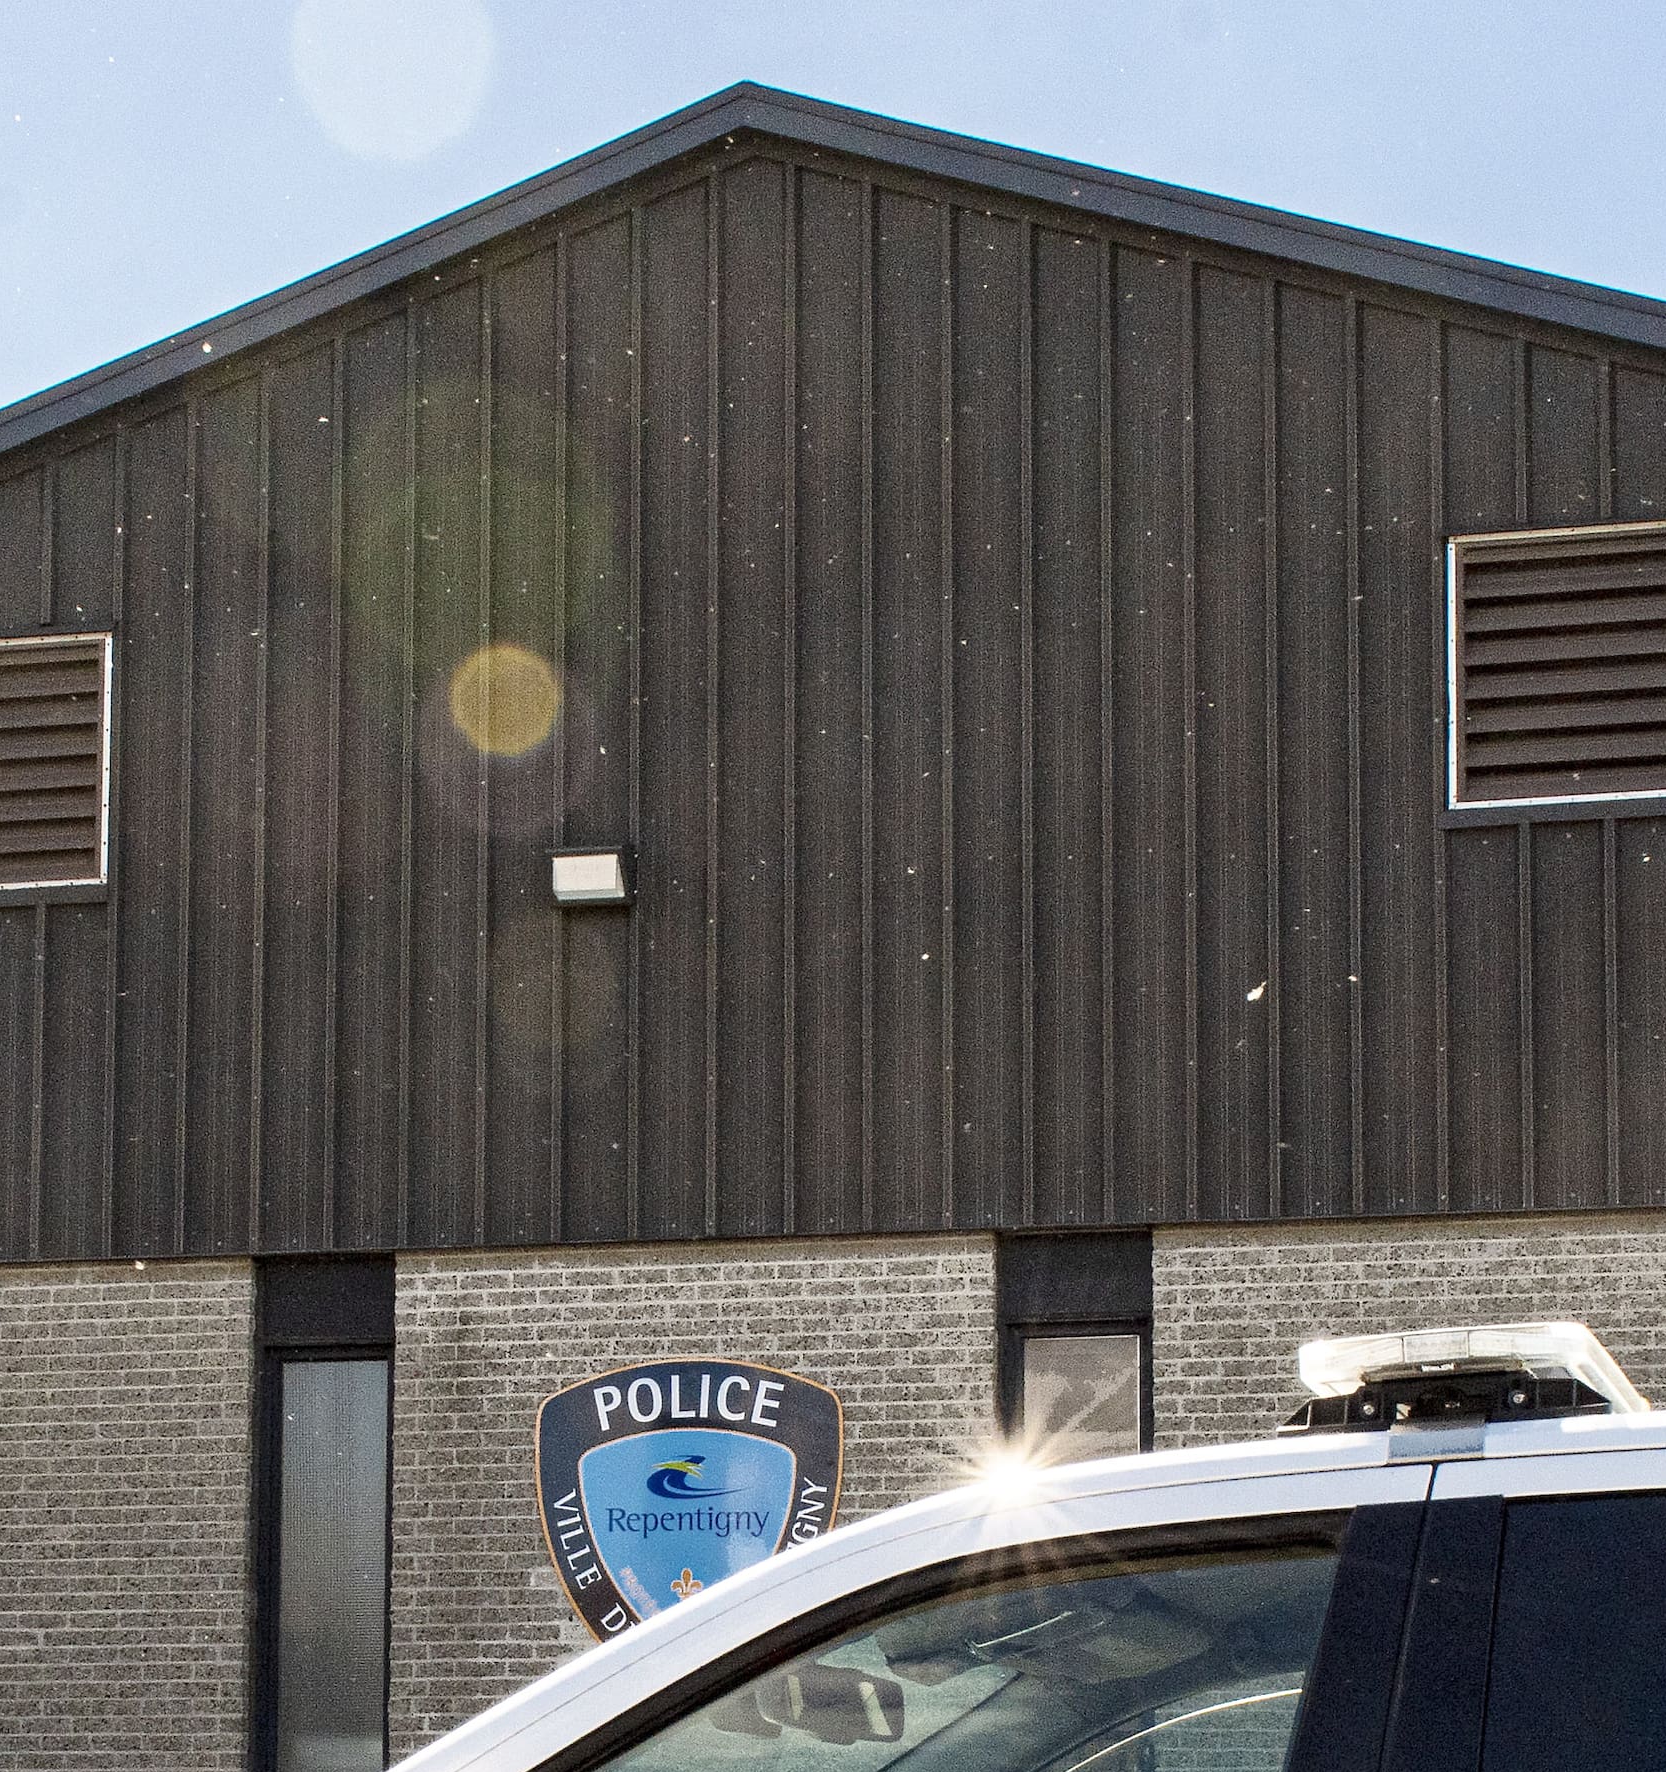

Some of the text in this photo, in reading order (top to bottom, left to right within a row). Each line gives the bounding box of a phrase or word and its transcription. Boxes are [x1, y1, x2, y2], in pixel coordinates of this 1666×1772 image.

[593, 1374, 785, 1431] POLICE
[605, 1506, 770, 1538] Repentigny
[553, 1488, 603, 1590] VILLE
[600, 1602, 637, 1635] D
